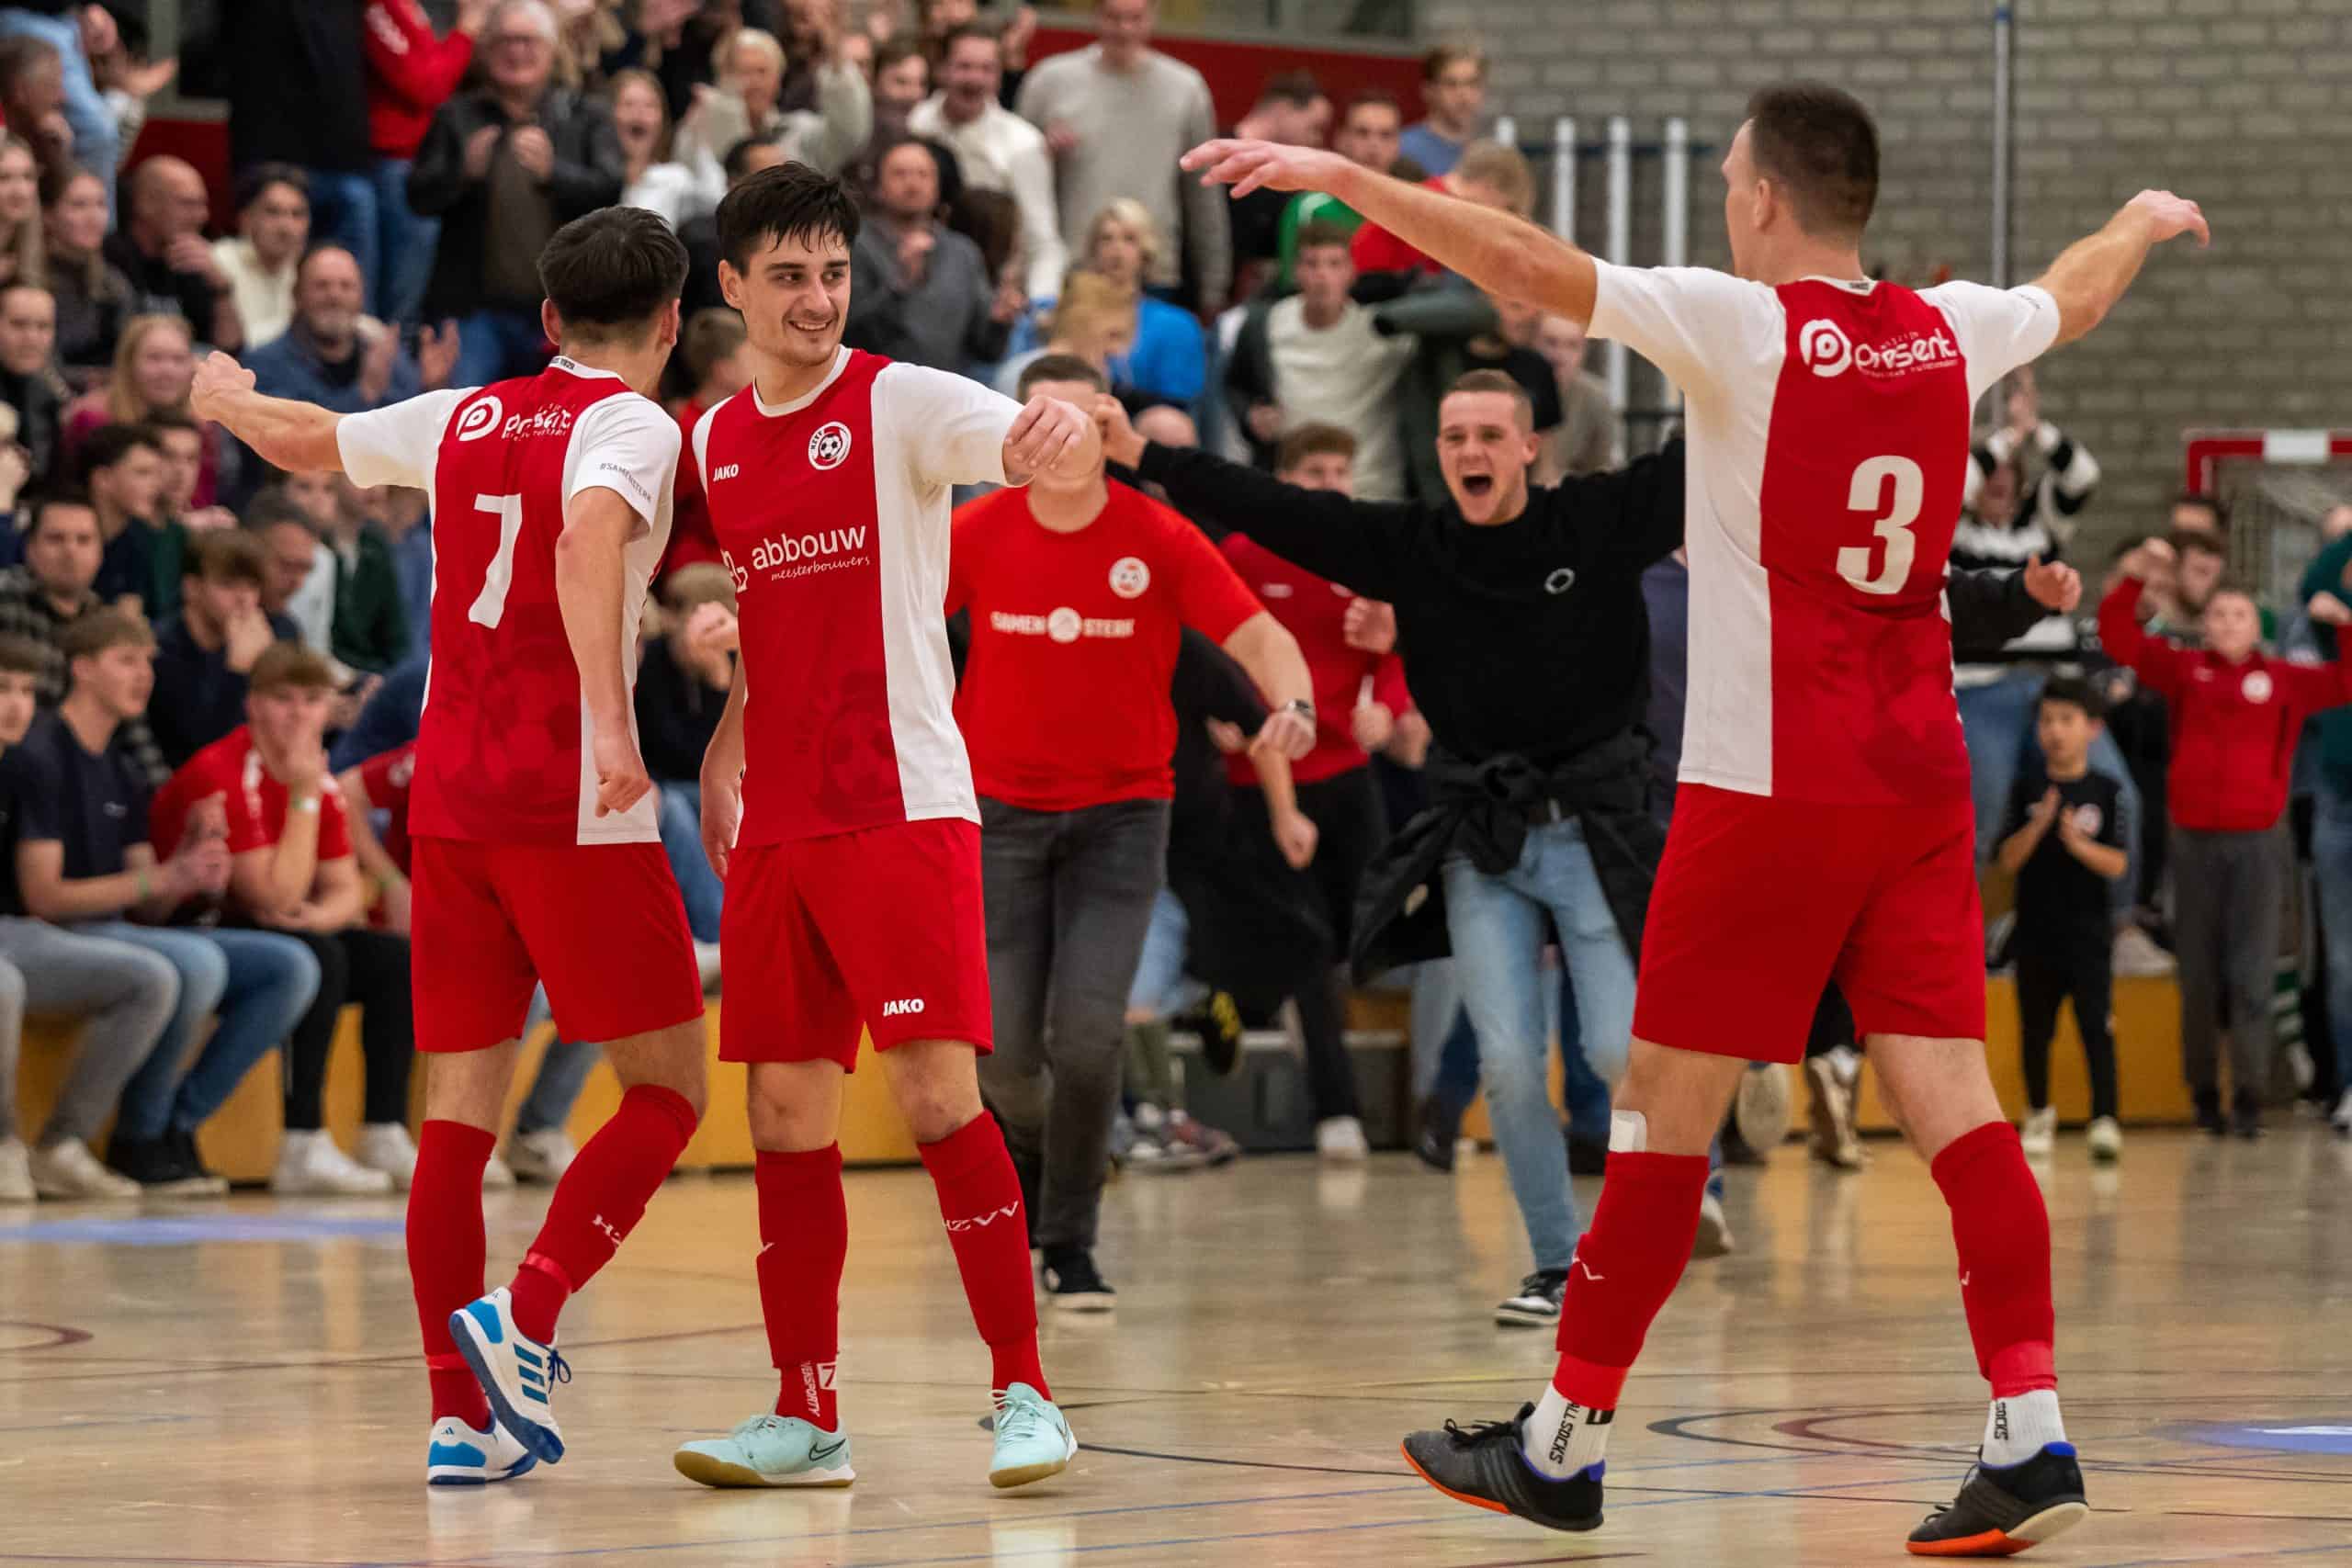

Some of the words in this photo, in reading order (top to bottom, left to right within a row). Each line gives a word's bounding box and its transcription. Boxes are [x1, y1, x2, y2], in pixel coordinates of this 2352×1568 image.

[713, 464, 739, 481] JAKO
[1837, 455, 1924, 594] 3
[469, 493, 522, 629] 7
[752, 525, 866, 570] abbouw
[771, 555, 871, 581] meesterbouwers
[883, 998, 924, 1017] JAKO
[1549, 1419, 1574, 1465] SOCKS
